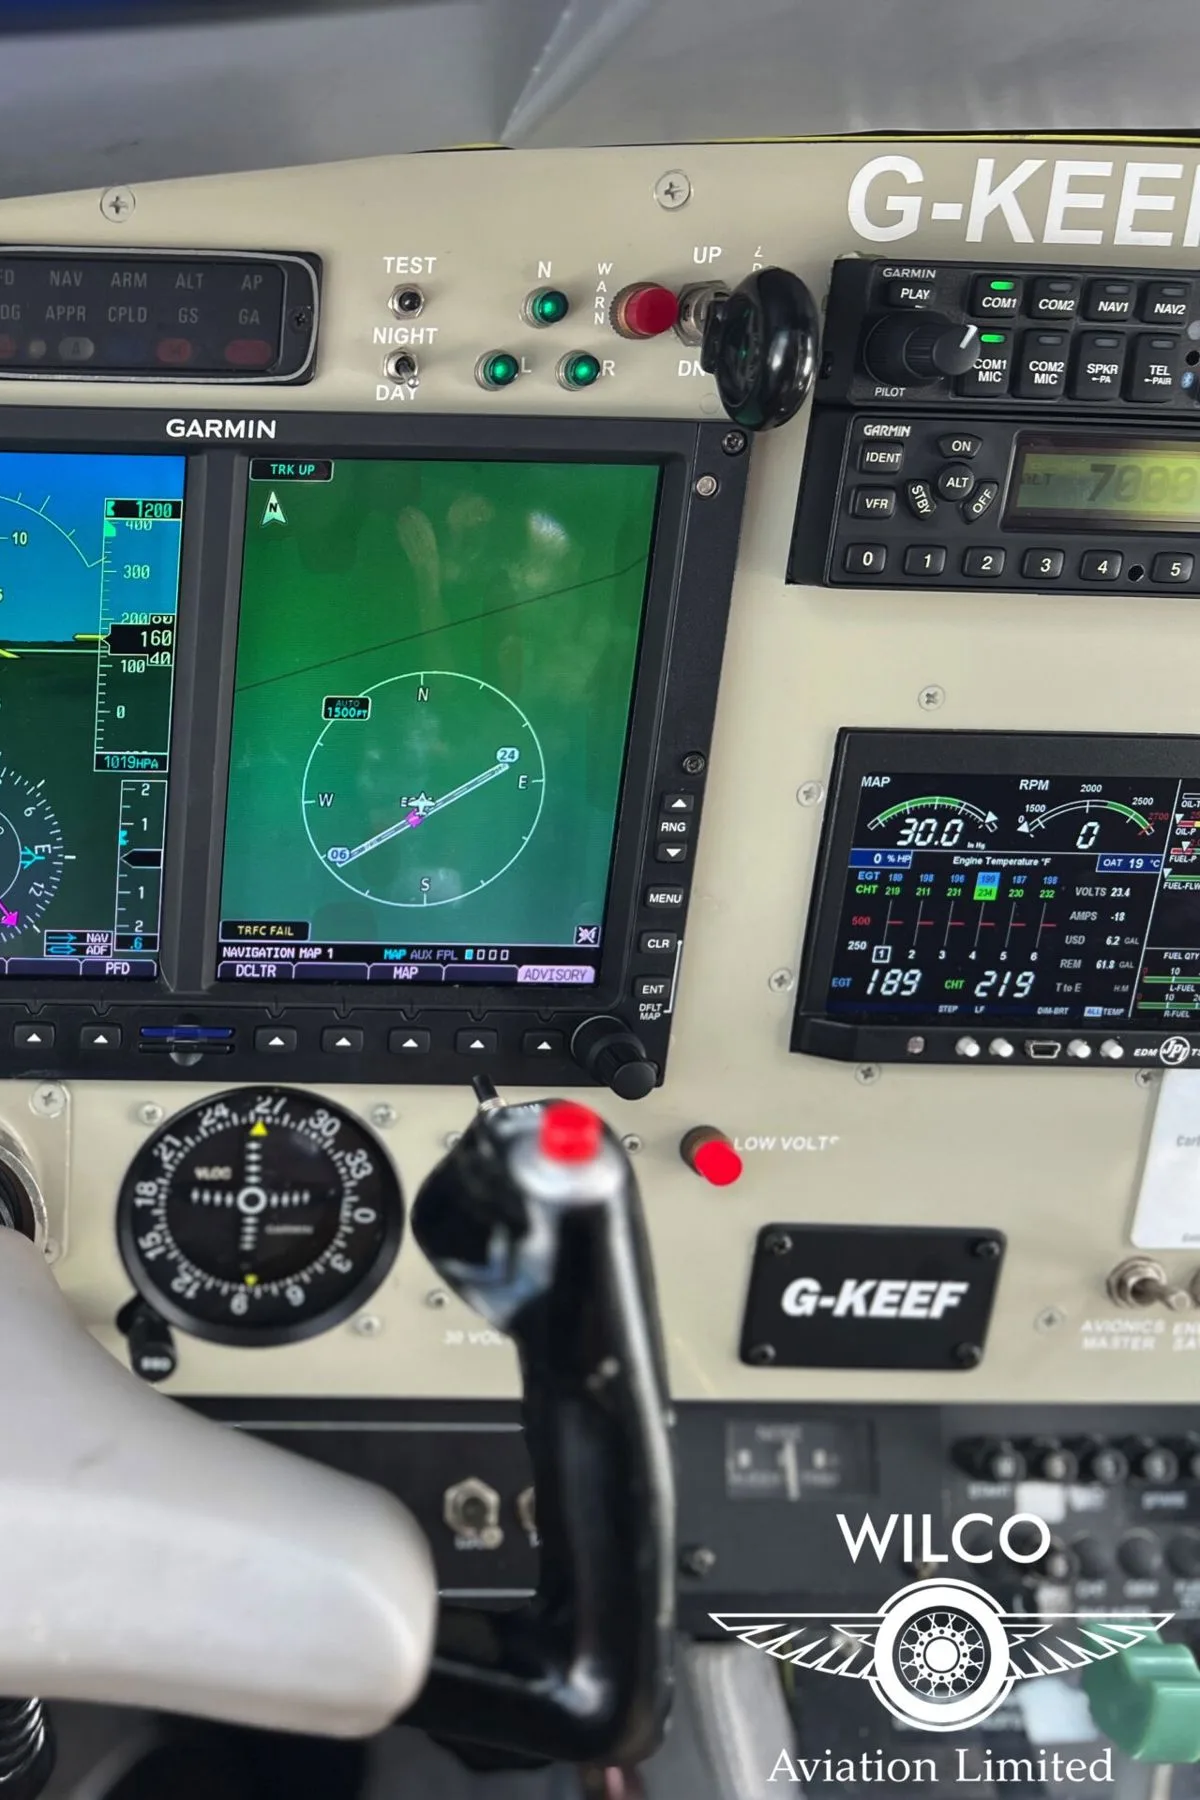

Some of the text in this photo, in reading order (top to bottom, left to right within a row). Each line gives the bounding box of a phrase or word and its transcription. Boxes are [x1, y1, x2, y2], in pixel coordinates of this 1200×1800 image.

[846, 155, 1200, 247] G-KEE
[693, 246, 722, 264] UP
[383, 256, 437, 274] TEST
[882, 267, 937, 279] GARMIN
[50, 270, 204, 290] NAV ARM ALT
[901, 288, 931, 301] PLAY
[982, 296, 1017, 310] COM1
[1038, 298, 1075, 312] COM2
[1097, 301, 1129, 313] NAV1
[1154, 302, 1186, 316] NAV2
[46, 305, 87, 323] APPR
[108, 306, 147, 324] CPLD
[373, 327, 438, 345] NIGHT
[1029, 360, 1064, 373] COM2
[1086, 363, 1119, 376] SPKR
[1149, 364, 1171, 377] TEL
[977, 369, 1003, 383] MIC
[1033, 372, 1059, 385] MIC
[376, 385, 418, 401] DAY
[874, 387, 906, 398] PILOT
[165, 418, 277, 440] GARMIN
[863, 424, 911, 438] GARMIN
[951, 440, 972, 453] ON
[865, 451, 902, 464] IDENT
[270, 464, 295, 476] TRK
[945, 477, 969, 489] ALT
[865, 497, 889, 510] VFR
[910, 484, 932, 516] STBY
[136, 501, 173, 518] 1200
[123, 565, 151, 579] 300
[1040, 558, 1052, 573] 3
[1170, 562, 1181, 577] 5
[104, 756, 160, 769] 1019HPA
[860, 775, 891, 788] MAP
[1019, 779, 1050, 791] RPM
[1079, 784, 1103, 794] 2000
[1024, 803, 1046, 814] 1500
[1132, 797, 1154, 807] 2500
[661, 821, 687, 833] RNG
[896, 817, 964, 848] 30.0
[1175, 827, 1197, 837] OIL-P
[1128, 857, 1145, 869] 19
[1170, 855, 1198, 864] FUEL-P
[649, 892, 682, 904] MENU
[1075, 886, 1107, 897] VOLTS
[1070, 911, 1098, 922] AMPS
[237, 925, 294, 937] TRFC FAIL
[647, 937, 670, 950] CLR
[1065, 935, 1140, 946] USD GAL
[222, 947, 296, 959] NAVIGATION
[1163, 952, 1183, 961] FUEL
[105, 963, 131, 975] PFD
[1060, 959, 1135, 970] REM GAL
[235, 964, 589, 982] DCLTR MAP ADVISORY
[642, 983, 665, 995] ENT
[733, 1135, 778, 1151] LOW
[344, 1149, 373, 1180] 33
[134, 1180, 159, 1209] 18
[780, 1276, 970, 1320] G-KEEF
